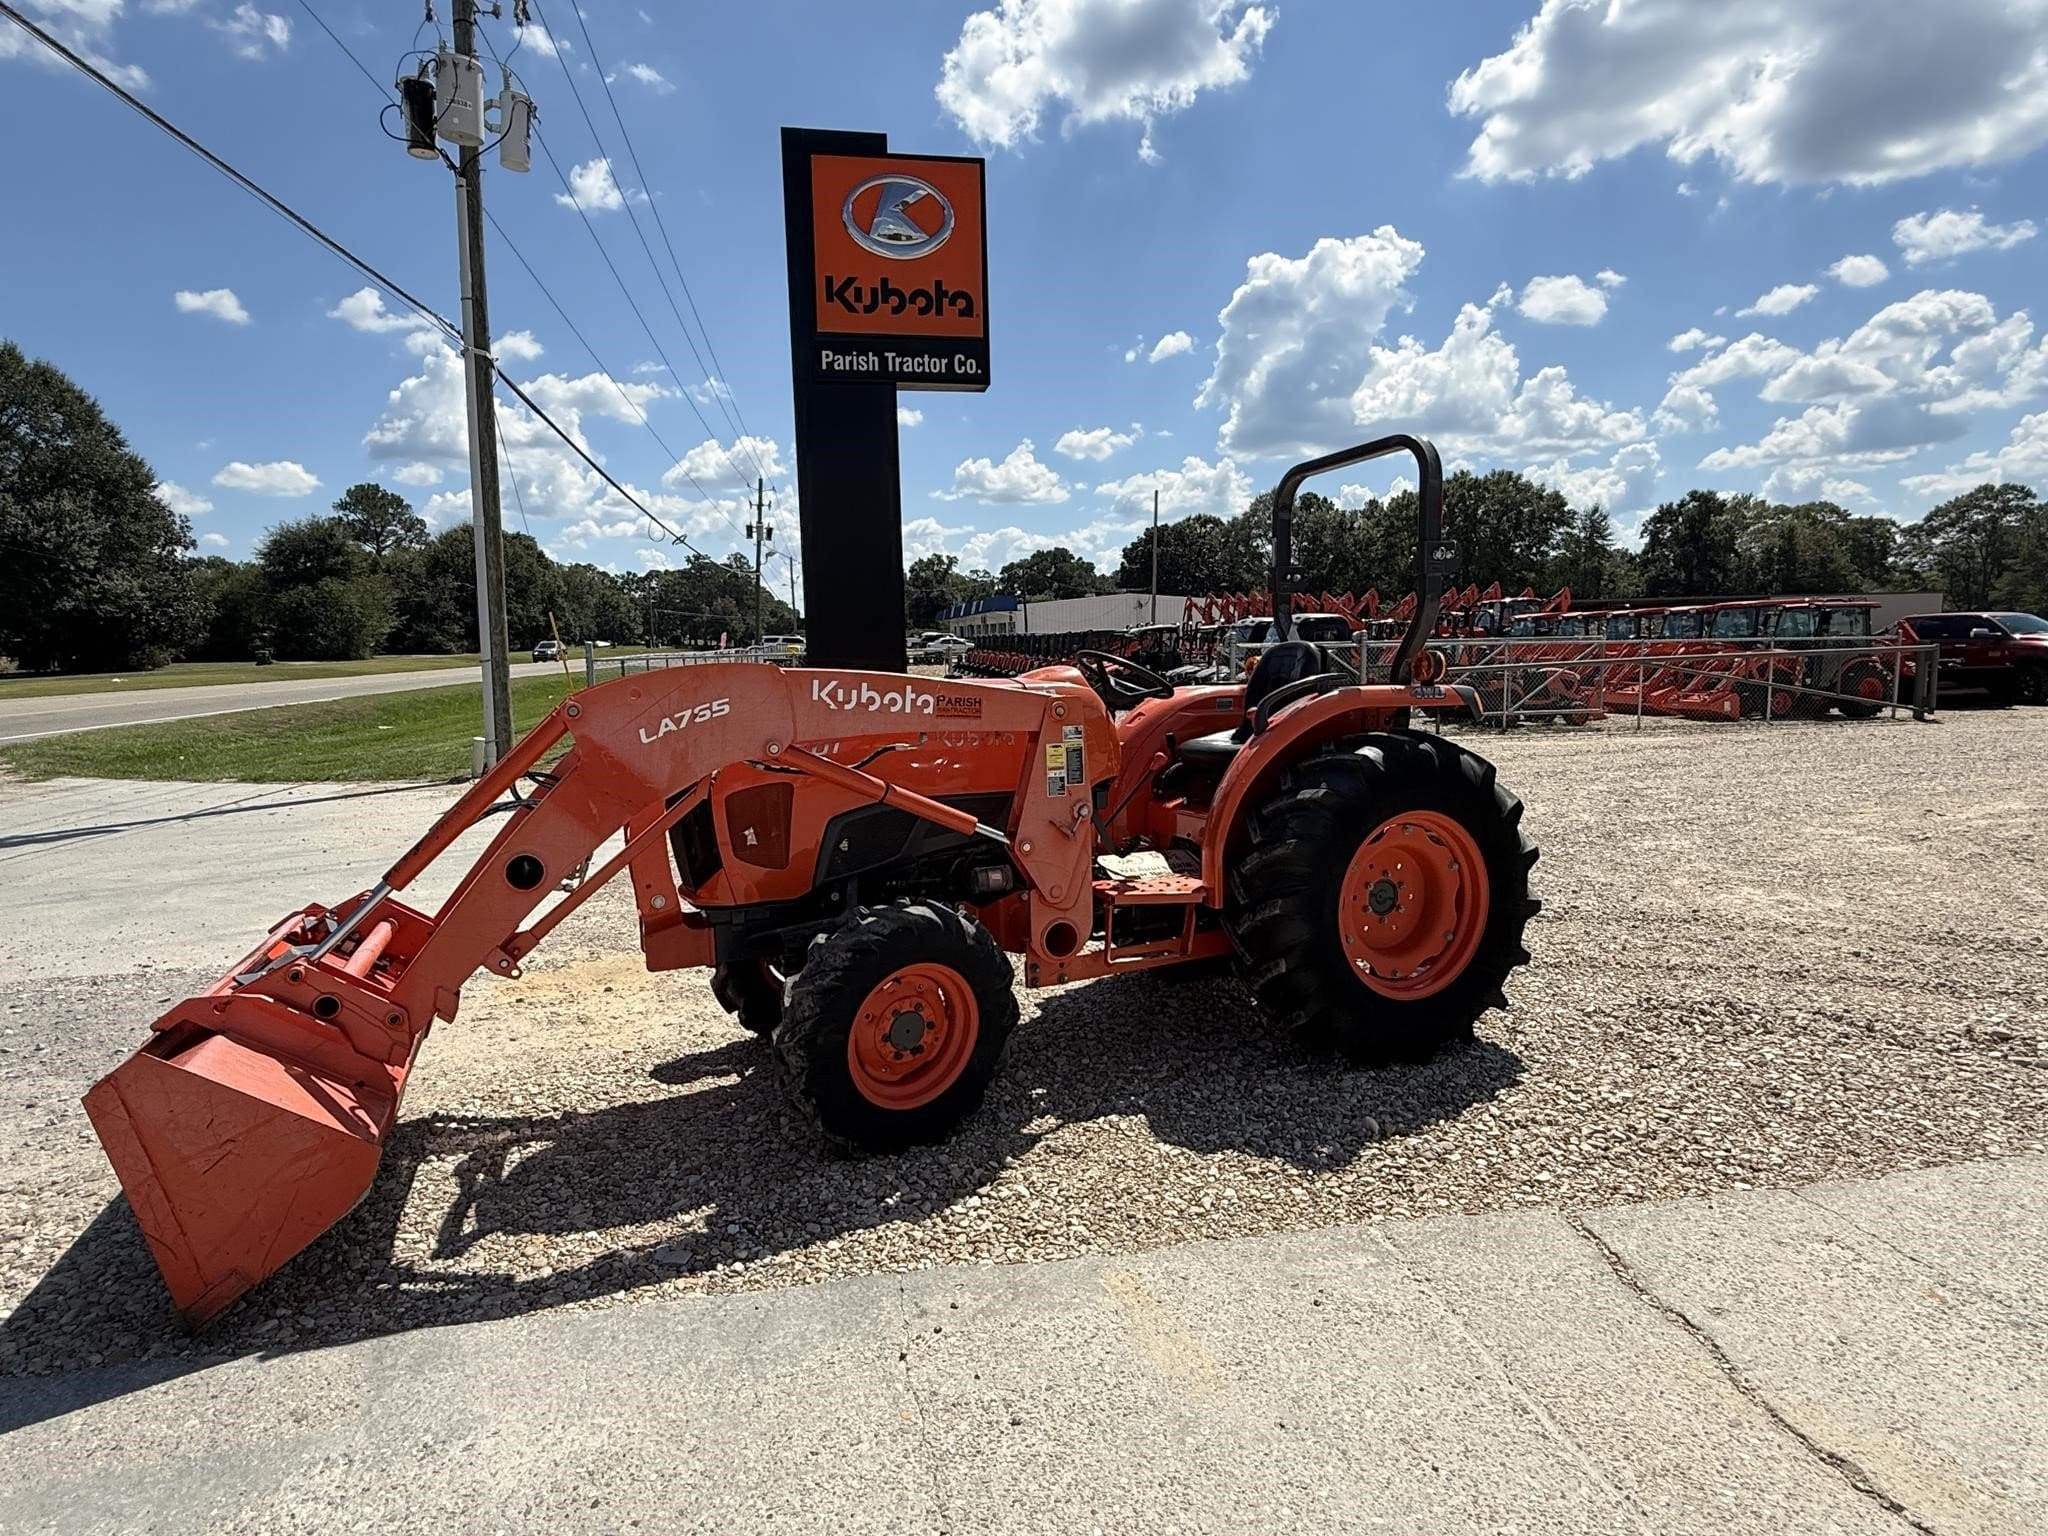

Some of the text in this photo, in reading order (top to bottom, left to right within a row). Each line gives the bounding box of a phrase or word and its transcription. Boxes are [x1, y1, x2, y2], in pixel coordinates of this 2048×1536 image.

[824, 275, 975, 318] Kubota
[821, 350, 983, 375] Parish Tractor Co.
[812, 679, 935, 715] Kubota
[638, 697, 731, 744] LA755
